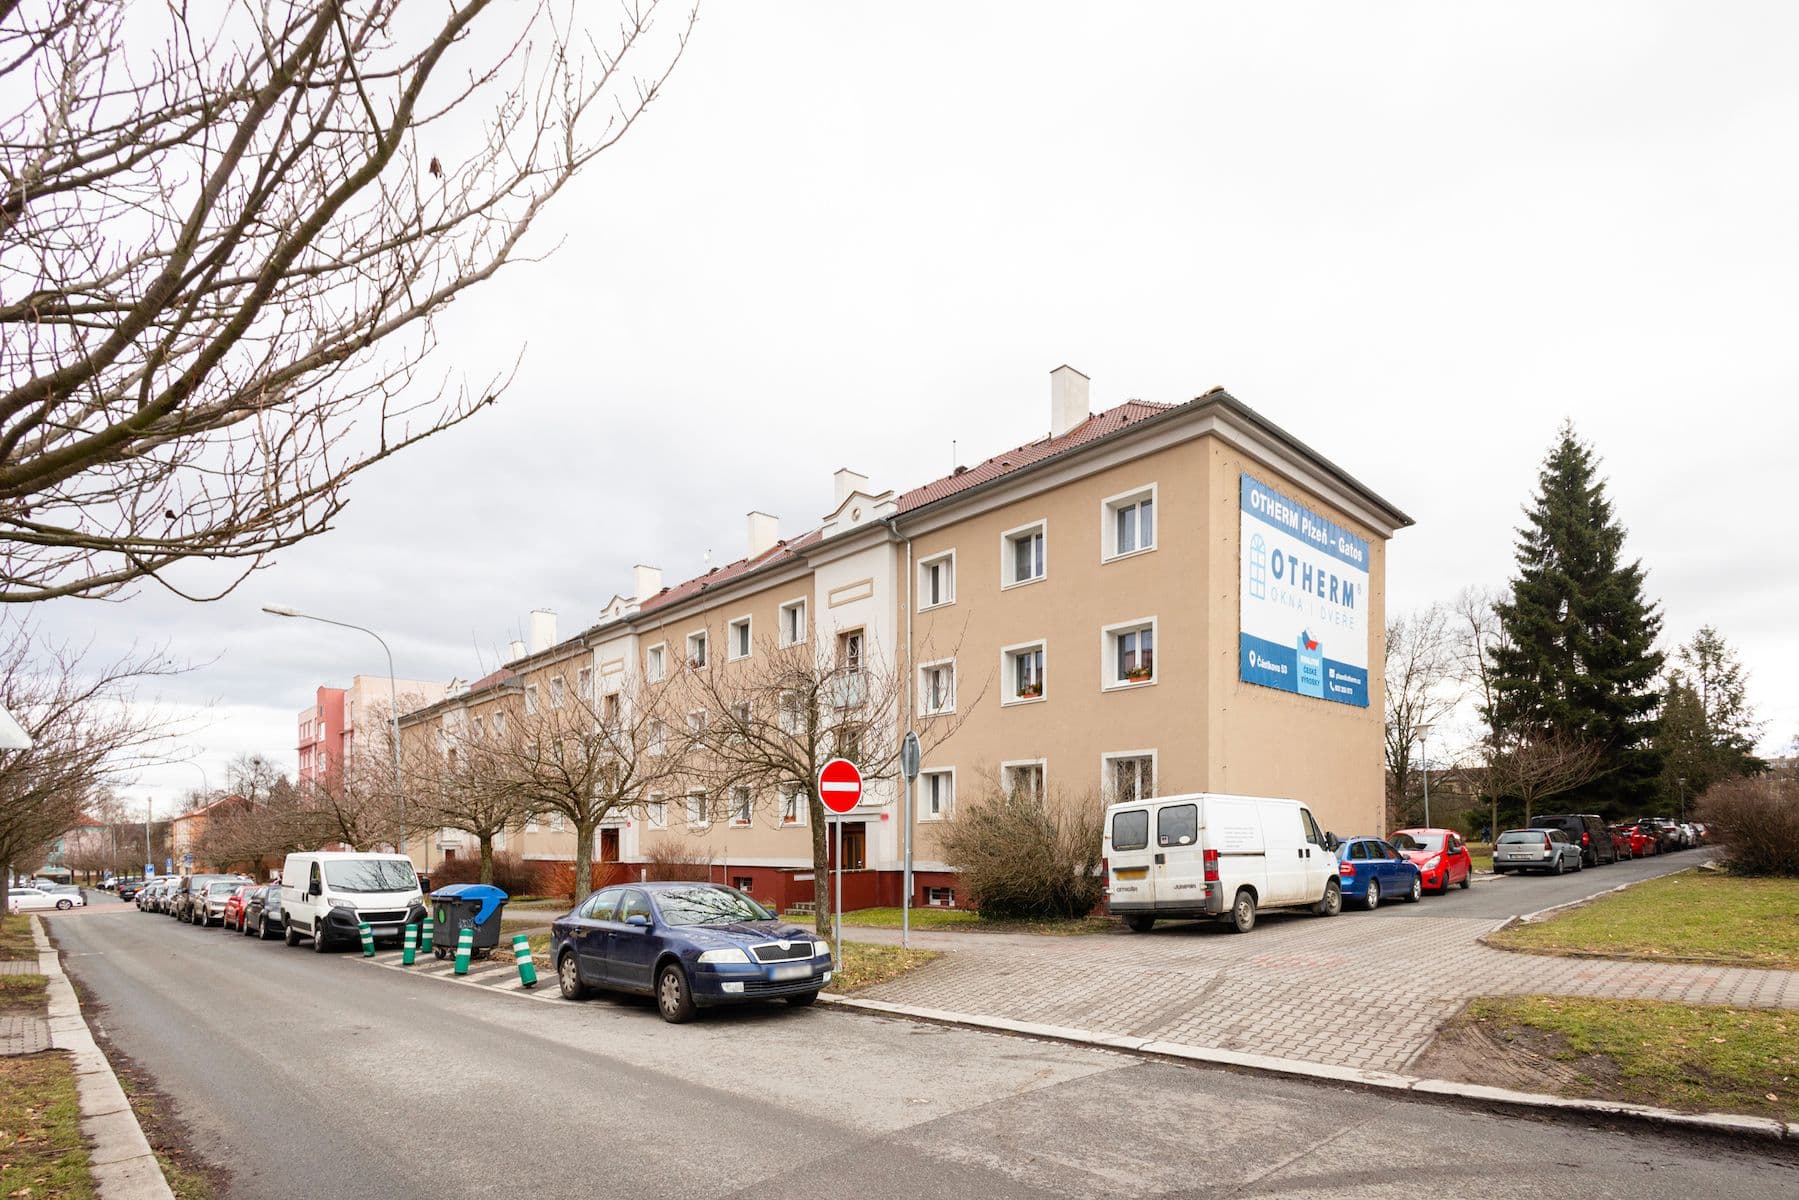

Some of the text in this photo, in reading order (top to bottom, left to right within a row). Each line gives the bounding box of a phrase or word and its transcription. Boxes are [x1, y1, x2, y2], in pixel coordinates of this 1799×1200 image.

[1251, 489, 1299, 530] OTHERM
[1302, 517, 1328, 545] Plzeň
[1338, 537, 1363, 562] Gatos
[1271, 548, 1354, 609] OTHERM
[1271, 586, 1304, 615] OKNA
